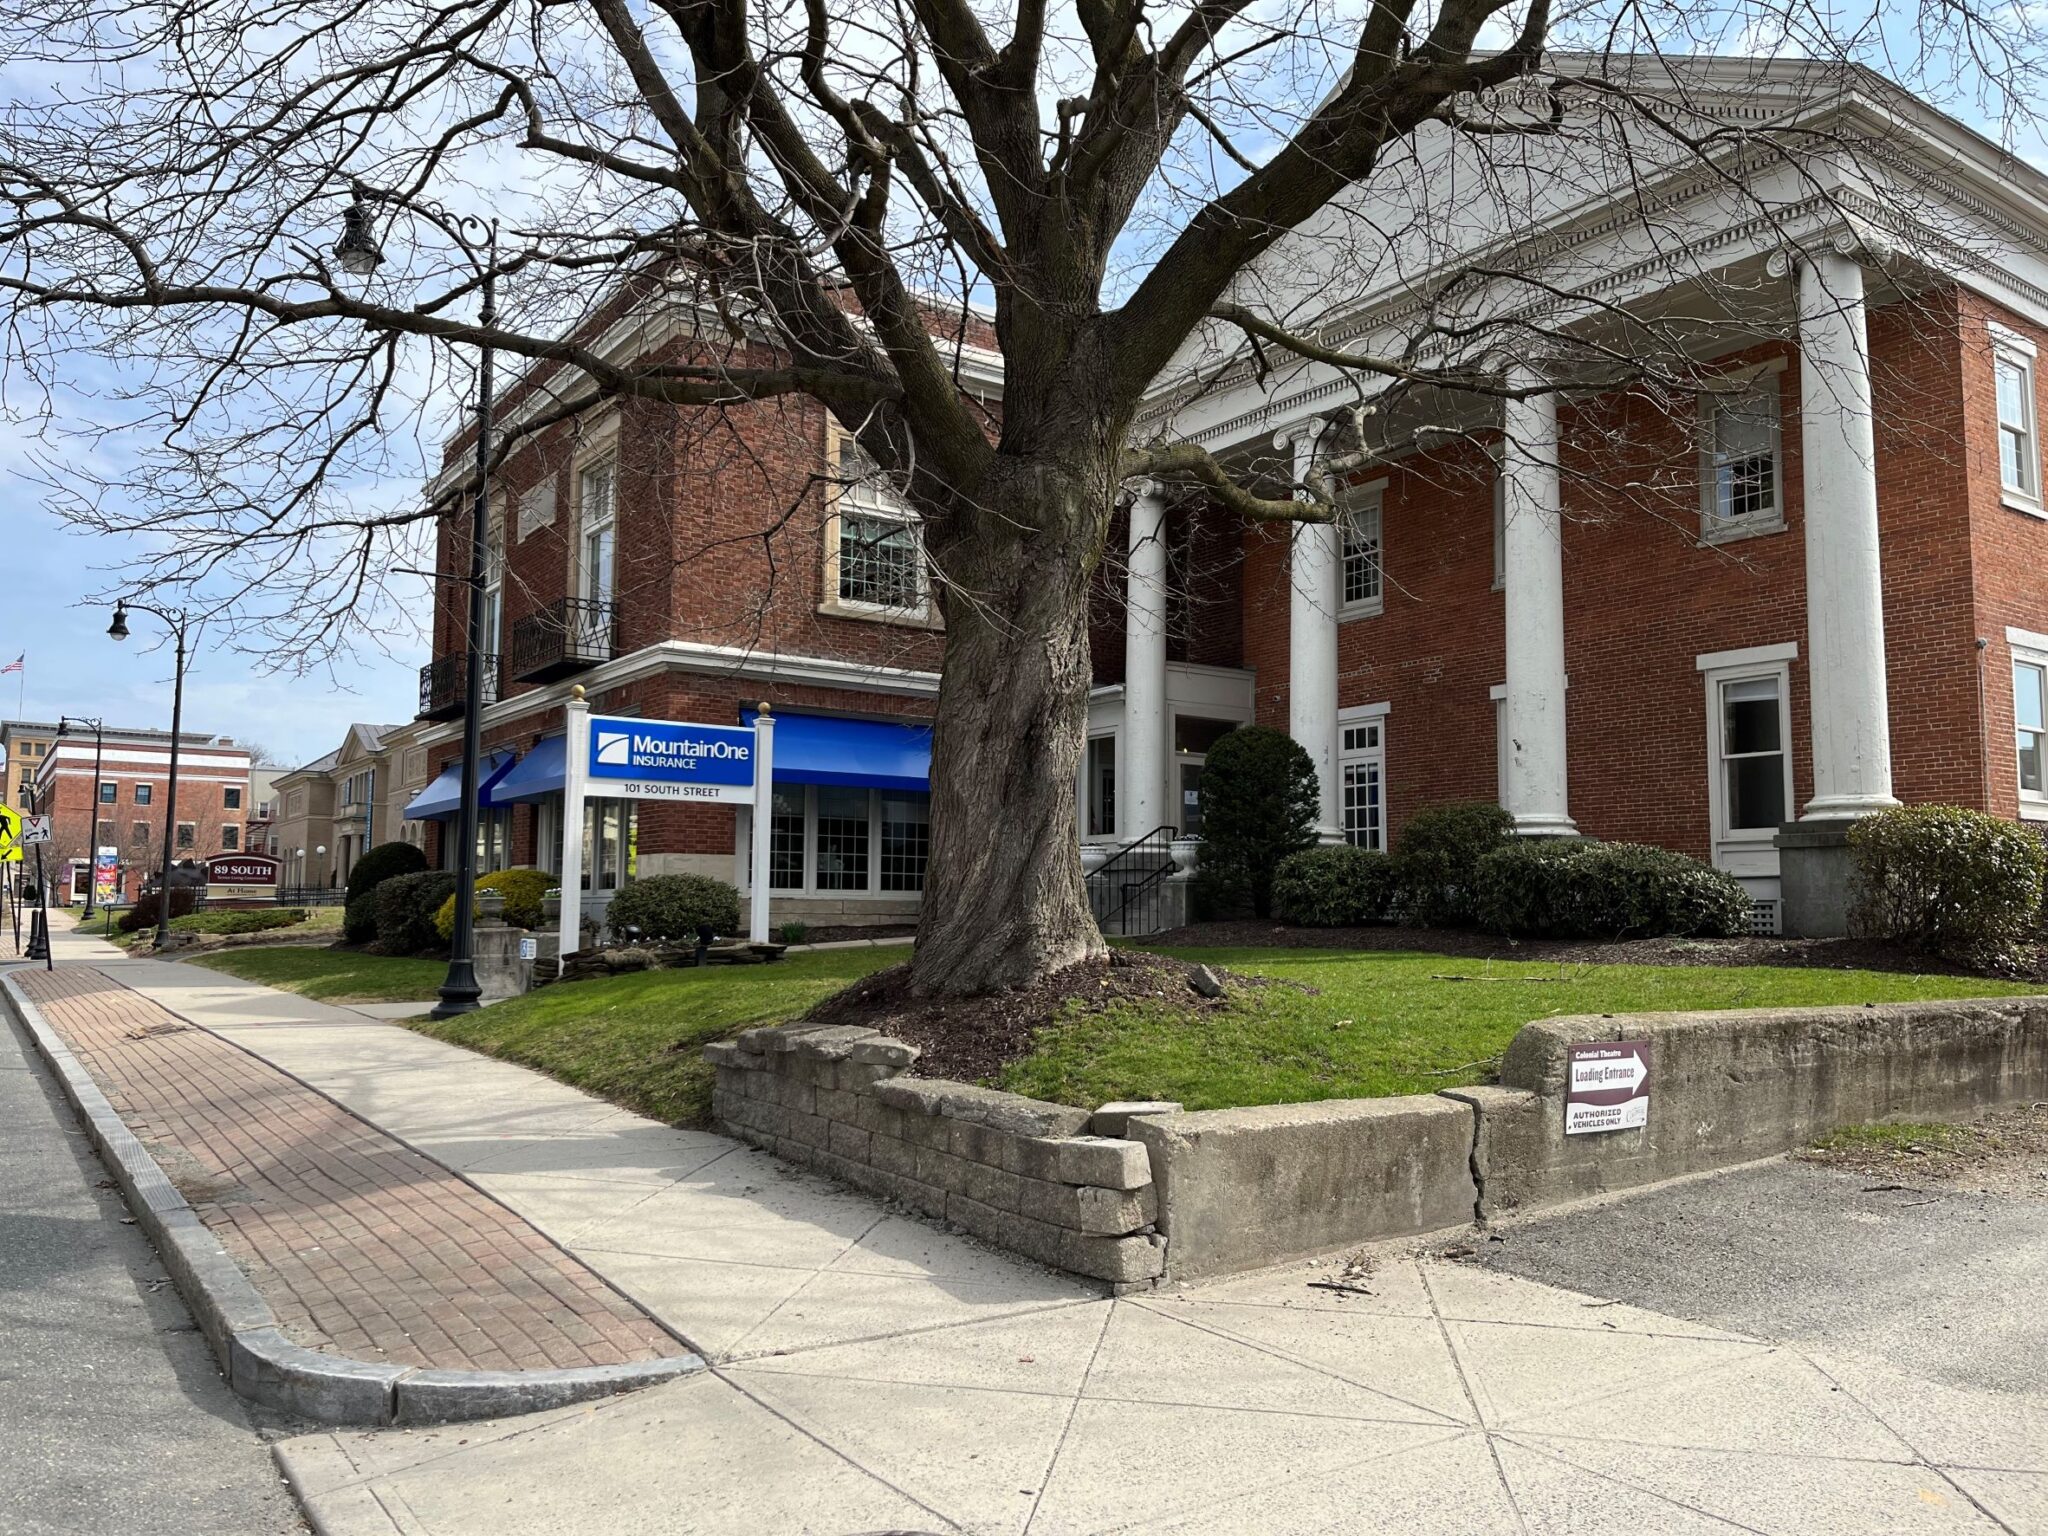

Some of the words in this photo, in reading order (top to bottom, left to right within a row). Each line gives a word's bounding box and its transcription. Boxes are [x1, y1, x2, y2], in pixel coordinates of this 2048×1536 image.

[633, 735, 749, 760] MountainOne
[633, 755, 696, 769] INSURANCE
[625, 784, 640, 793] 101
[645, 784, 679, 795] SOUTH
[684, 786, 720, 797] STREET
[214, 865, 228, 874] 89
[231, 866, 272, 875] SOUTH
[1576, 1051, 1599, 1059] Colonial
[1600, 1050, 1621, 1058] Theatre
[1576, 1068, 1603, 1083] Loading
[1604, 1067, 1634, 1080] Entrance
[1573, 1109, 1621, 1119] AUTHORIZED
[1573, 1119, 1604, 1129] VEHICLES
[1605, 1118, 1621, 1126] ONLY
